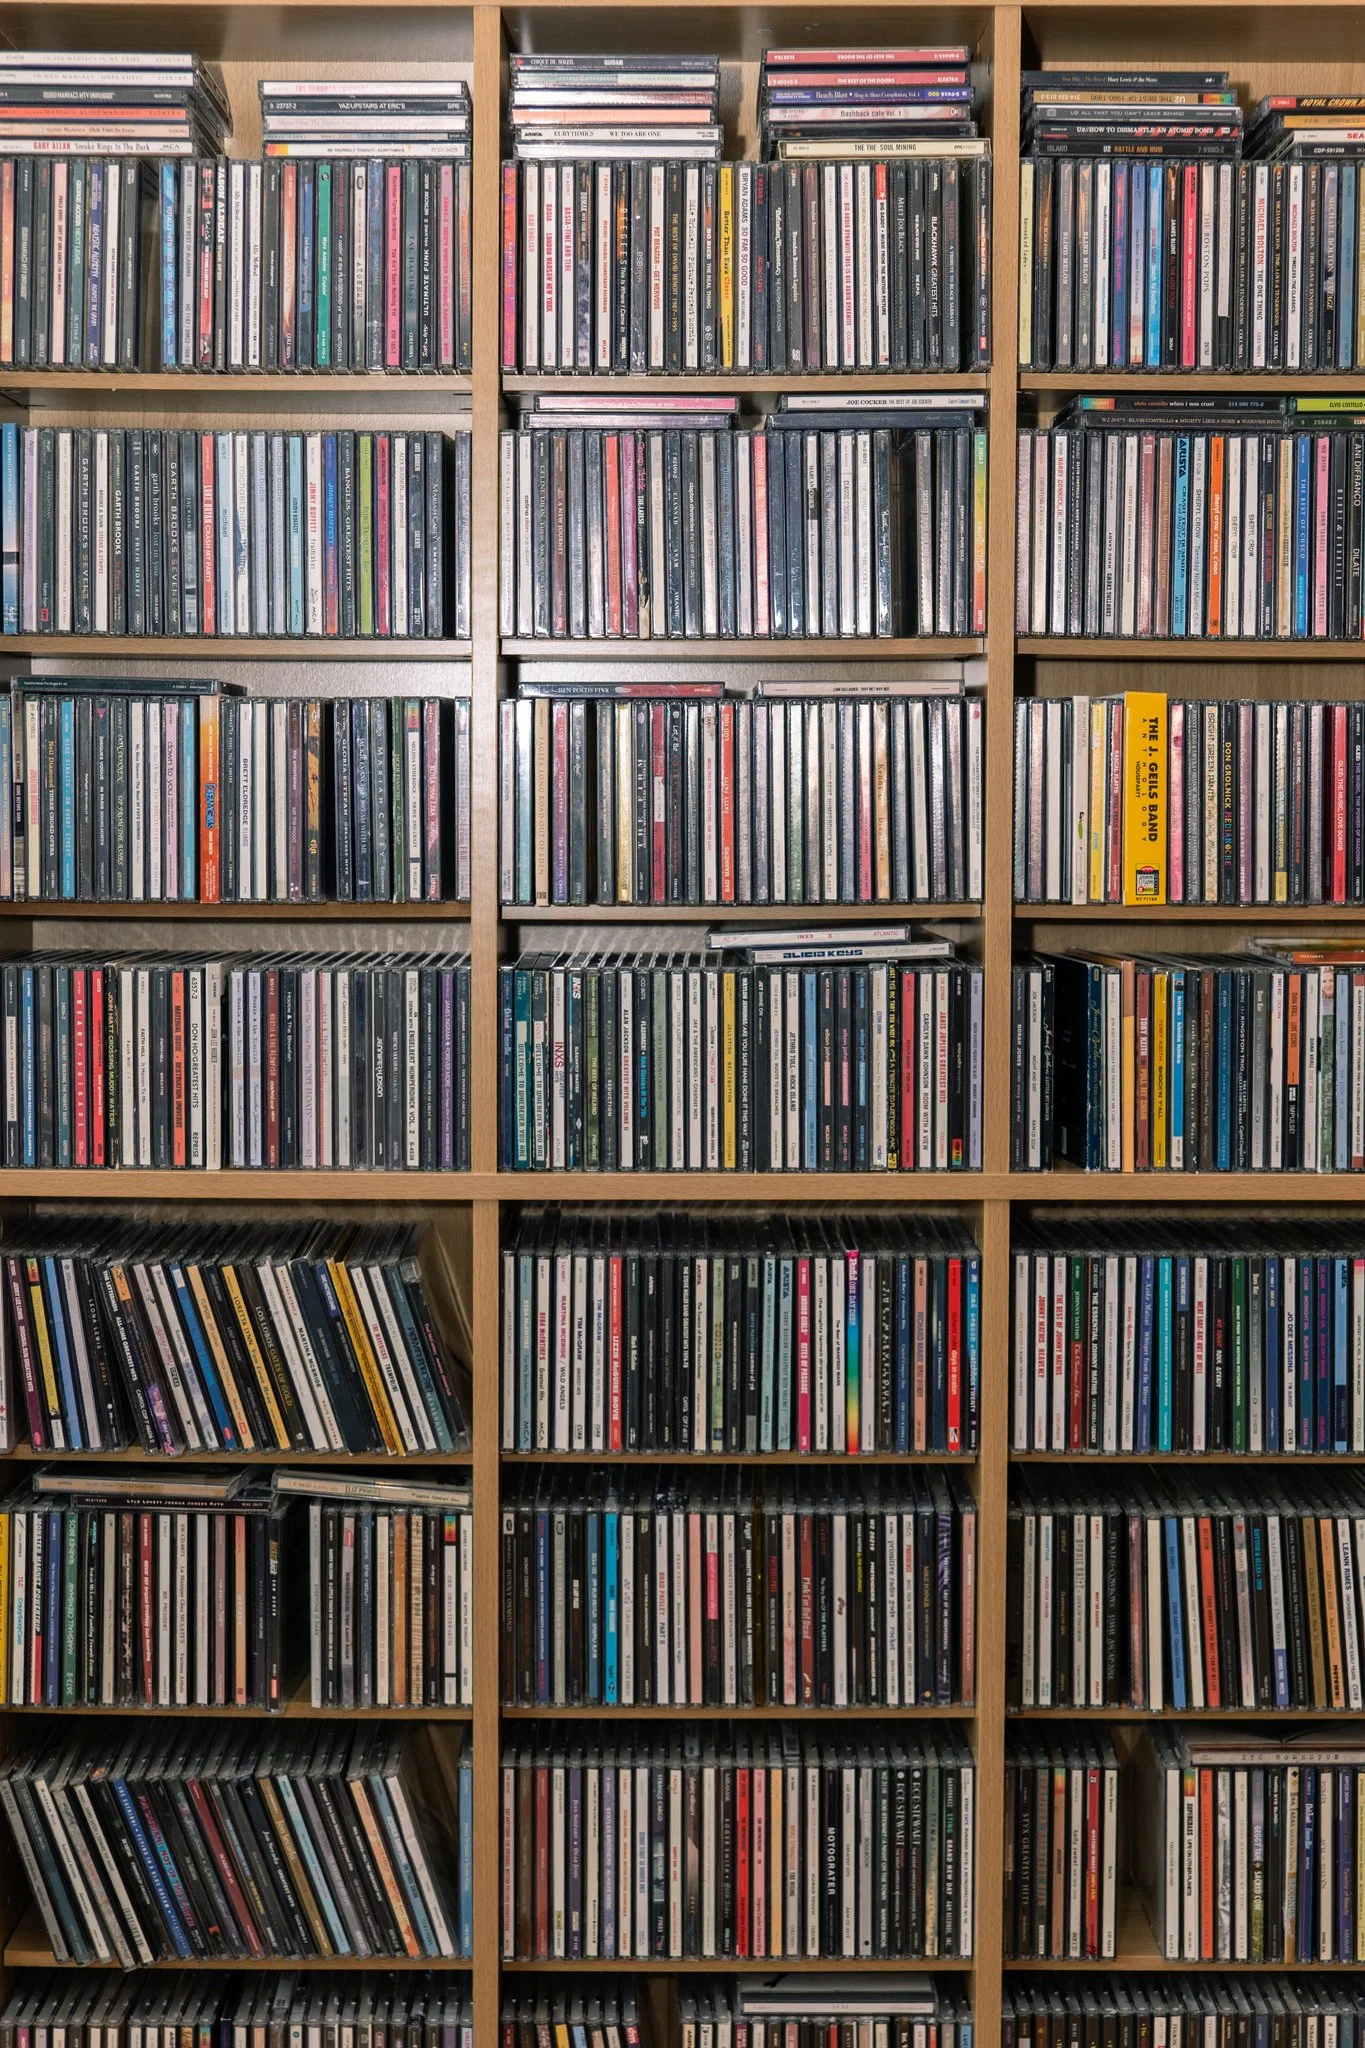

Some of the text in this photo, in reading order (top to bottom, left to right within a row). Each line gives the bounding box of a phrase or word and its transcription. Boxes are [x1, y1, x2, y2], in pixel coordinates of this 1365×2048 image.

[1300, 99, 1359, 107] ROYAL CROWN
[33, 141, 150, 152] GARY ALLAN Smoke Rings In The Dark
[741, 227, 748, 236] SO
[741, 254, 748, 263] SO
[1178, 440, 1187, 478] ARISTA
[206, 552, 211, 560] MY
[167, 768, 174, 777] to
[1148, 717, 1158, 841] THE J. GEILS BAND
[165, 780, 174, 795] you
[555, 1042, 564, 1068] INXS
[1288, 1312, 1293, 1322] JO
[1342, 1542, 1350, 1566] LEANN
